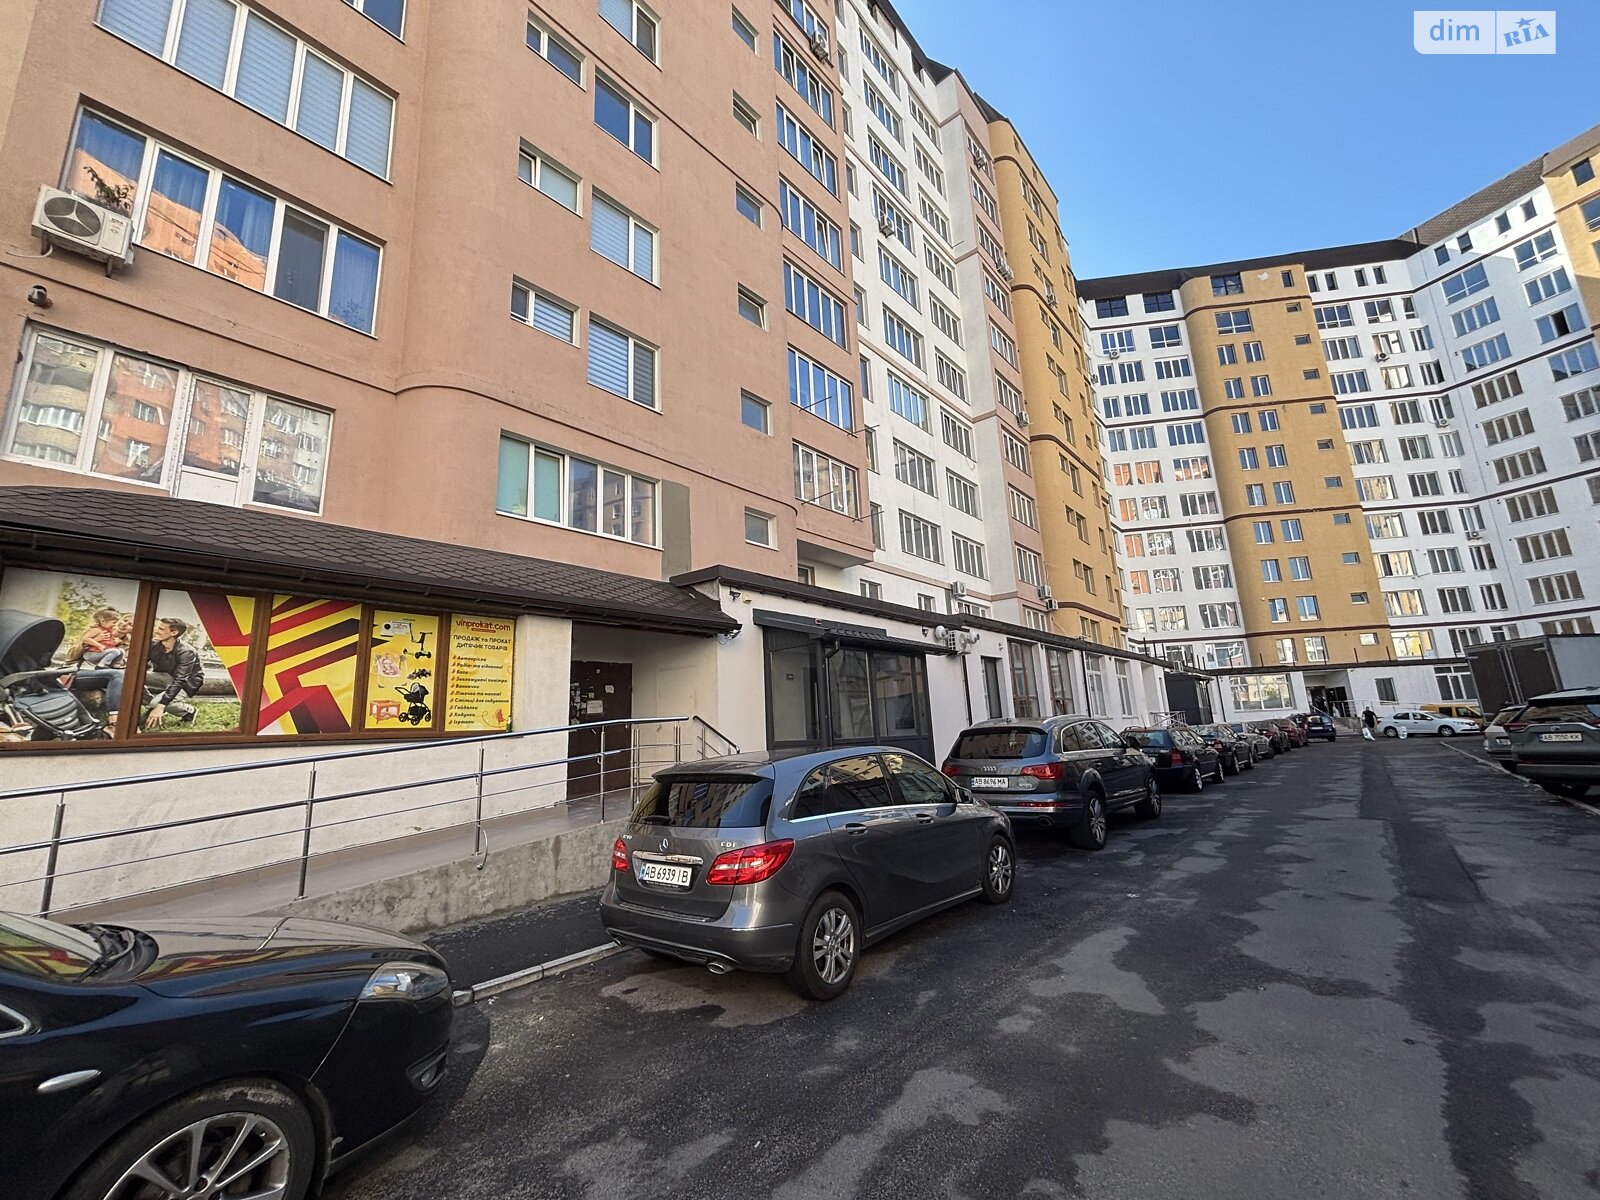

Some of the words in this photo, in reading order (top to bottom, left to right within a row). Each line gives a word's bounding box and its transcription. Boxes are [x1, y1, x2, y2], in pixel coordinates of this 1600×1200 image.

[456, 619, 510, 631] vinprokat.com
[644, 866, 656, 879] AB
[656, 866, 676, 882] 6939
[677, 869, 689, 884] IB
